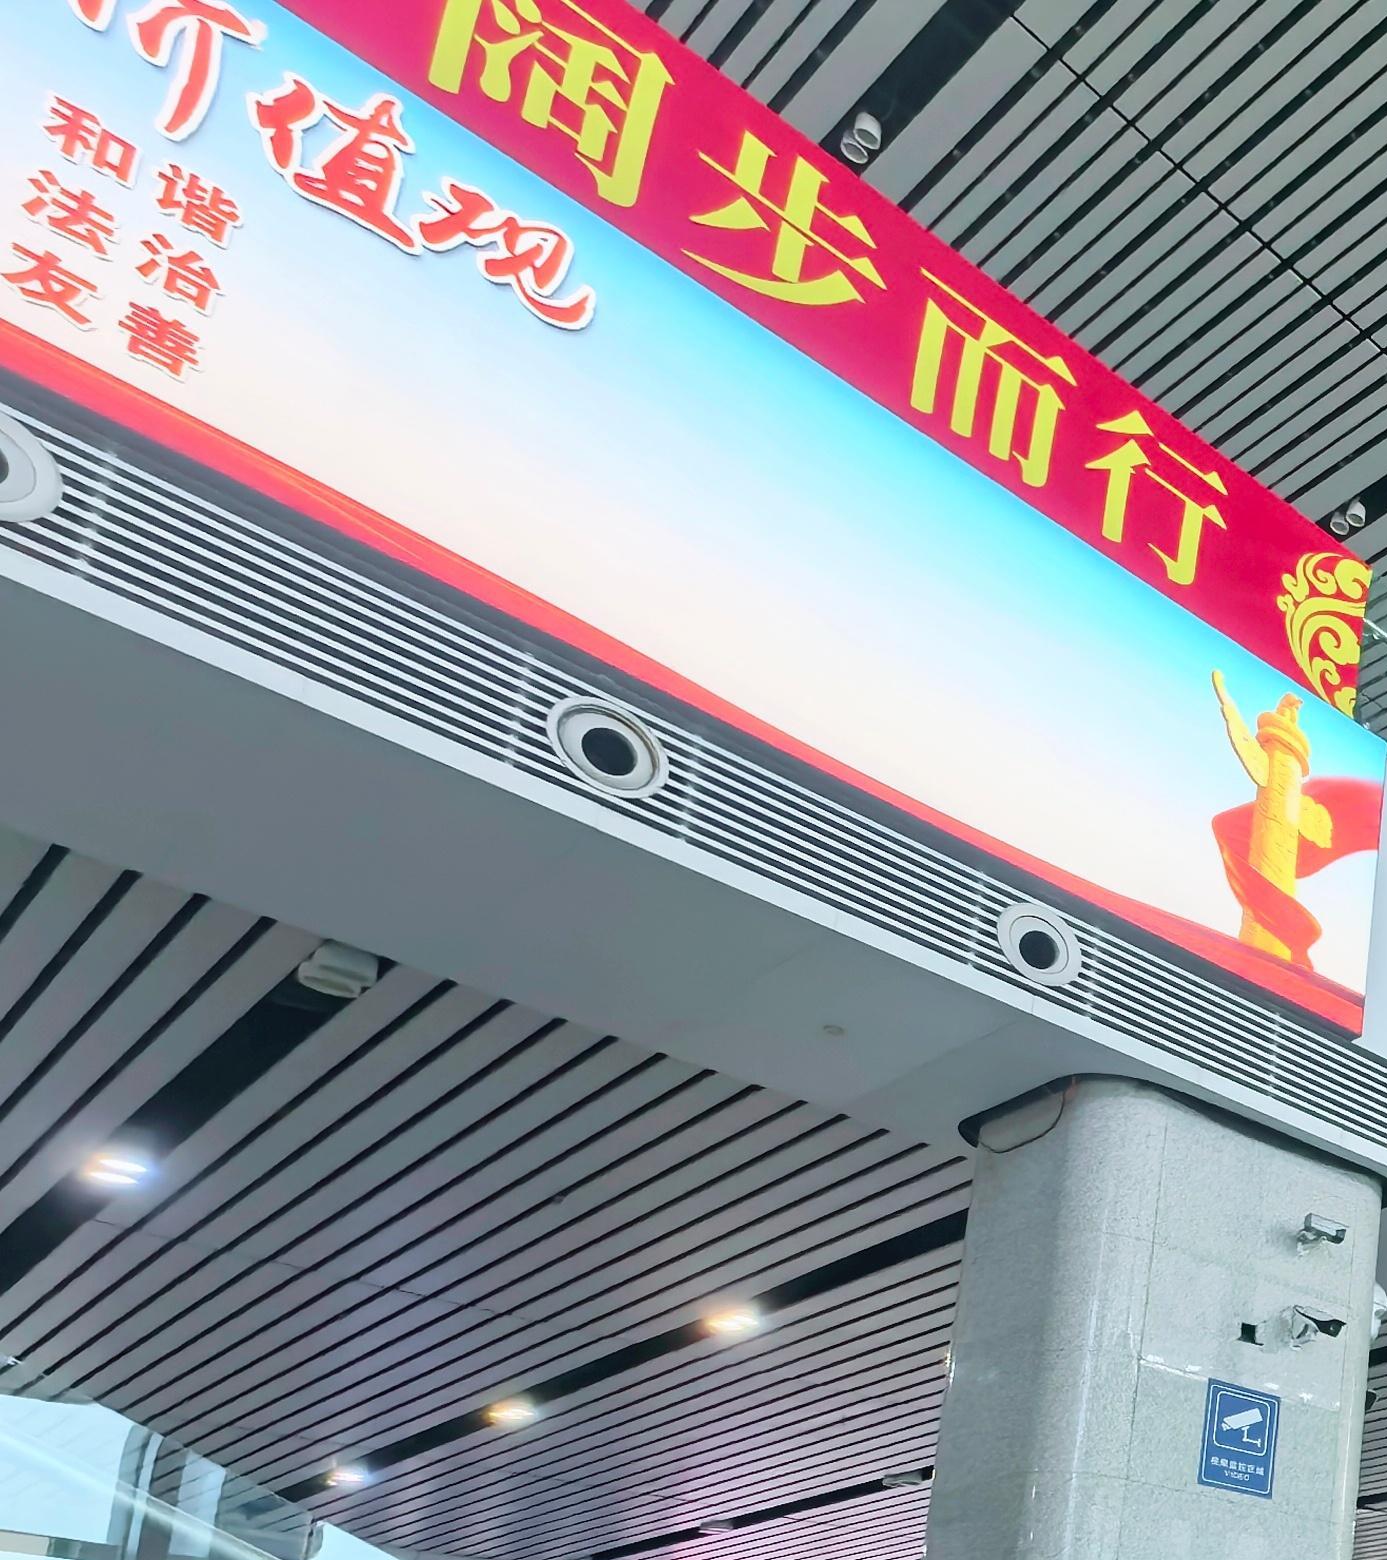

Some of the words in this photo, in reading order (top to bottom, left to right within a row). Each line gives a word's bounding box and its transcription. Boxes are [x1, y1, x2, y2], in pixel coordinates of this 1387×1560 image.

[21, 169, 224, 313] 法治
[43, 94, 242, 247] 和谐
[1, 241, 202, 378] 友善
[428, 0, 1227, 586] 阔步而行
[1224, 1470, 1250, 1481] VIDEO
